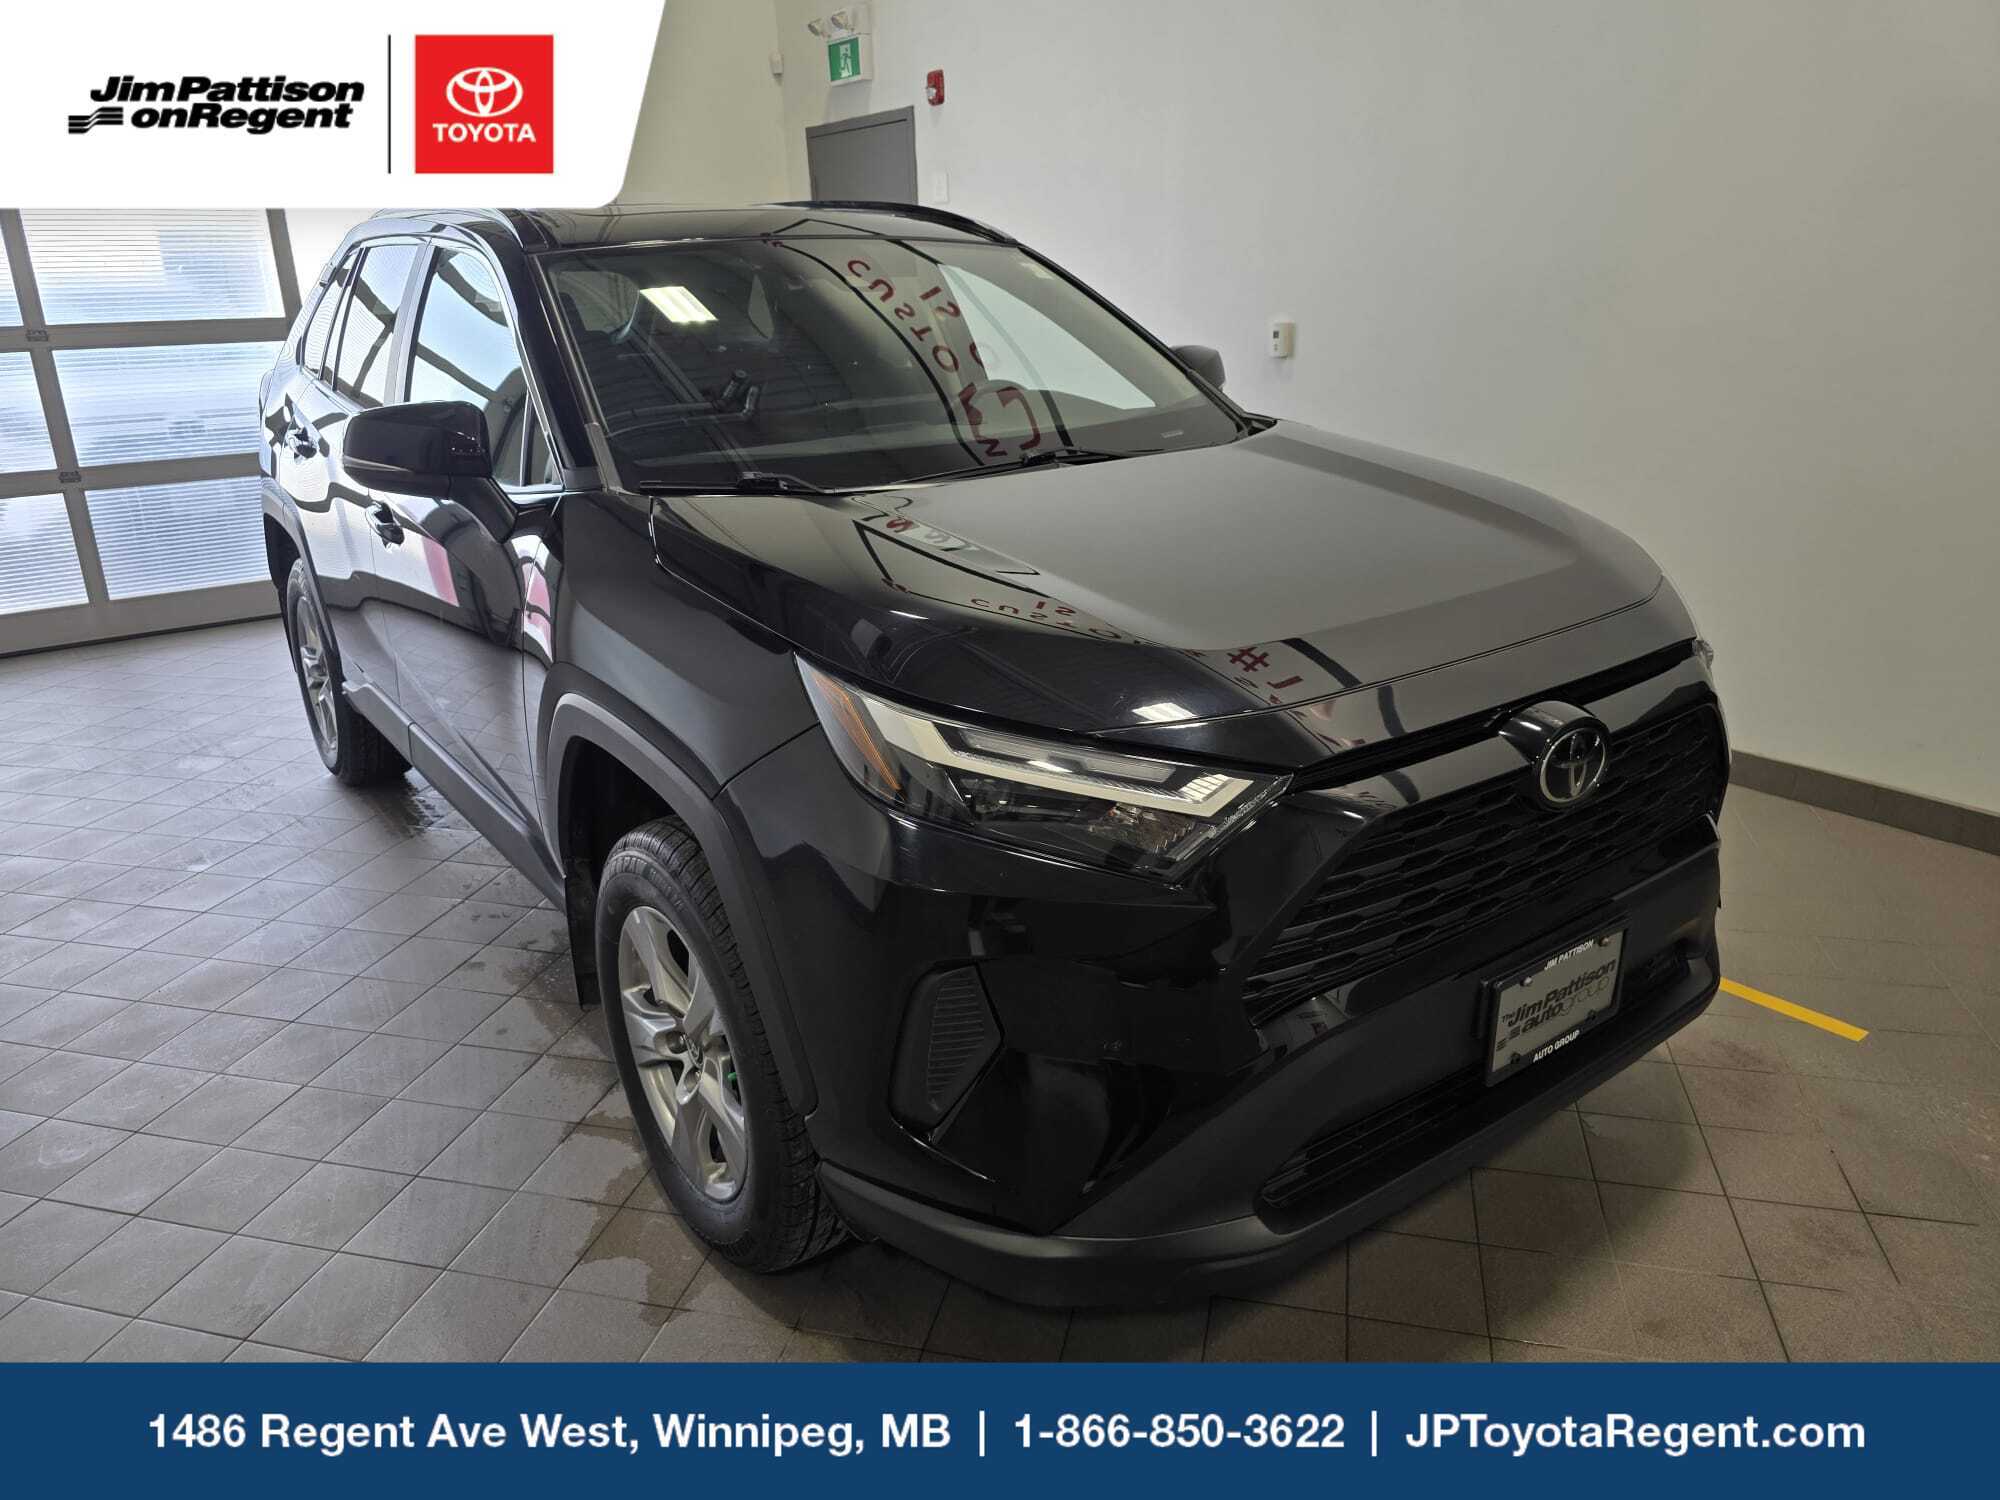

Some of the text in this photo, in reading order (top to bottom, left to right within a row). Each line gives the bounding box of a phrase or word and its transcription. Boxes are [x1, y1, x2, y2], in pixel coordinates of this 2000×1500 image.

[1544, 939, 1594, 971] JIM PATTISON
[1532, 1028, 1580, 1063] AUTO GROUP
